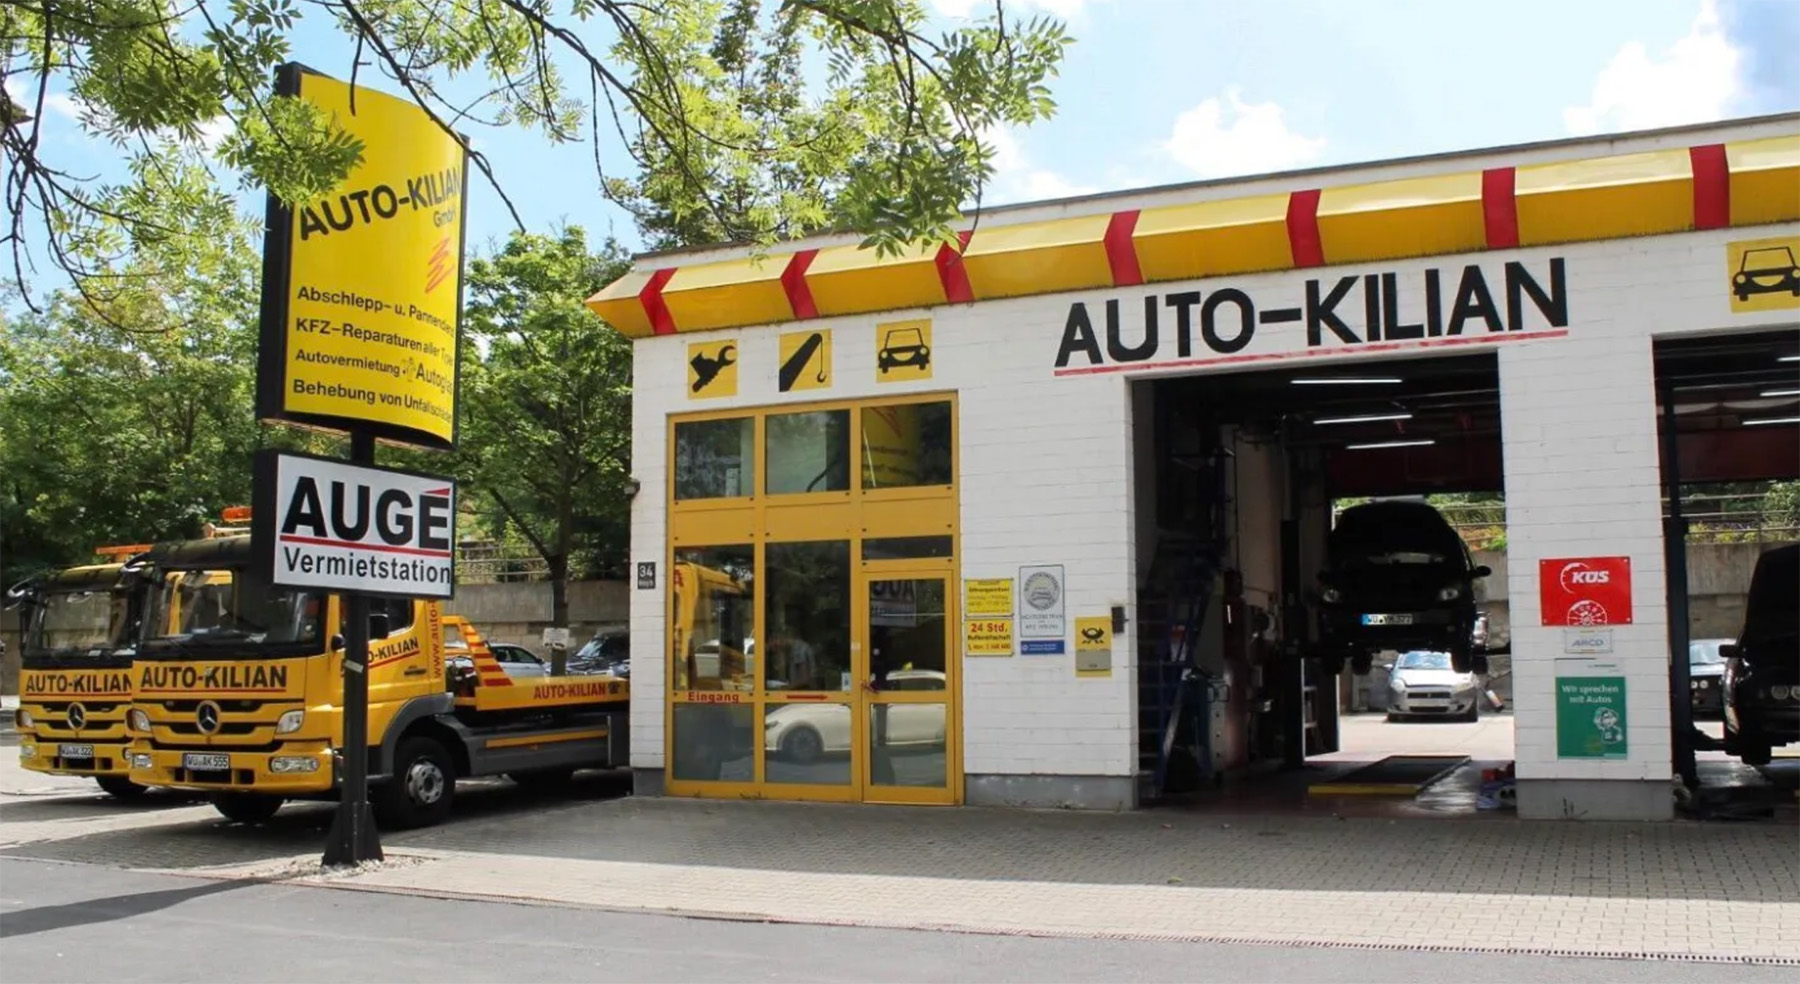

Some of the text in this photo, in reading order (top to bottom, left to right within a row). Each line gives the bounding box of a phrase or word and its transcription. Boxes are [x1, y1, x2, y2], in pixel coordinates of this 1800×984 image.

[300, 166, 461, 240] AUTO-KILIAN
[297, 286, 391, 313] Abschlepp-
[394, 304, 406, 317] u.
[1054, 257, 1568, 367] AUTO-KILIAN
[296, 317, 426, 352] KFZ-Reparaturen
[296, 348, 401, 378] Autovermietung
[293, 379, 376, 405] Behebung
[379, 392, 402, 407] von
[284, 546, 450, 584] Vermietstation
[971, 622, 1008, 633] 24 Std.
[26, 673, 132, 692] AUTO-KILIAN
[141, 665, 287, 689] AUTO-KILIAN
[1561, 684, 1619, 695] Wir sprechen
[534, 682, 606, 699] AUTO-KILIAN
[687, 691, 740, 705] Eingang
[1586, 695, 1612, 704] Autos
